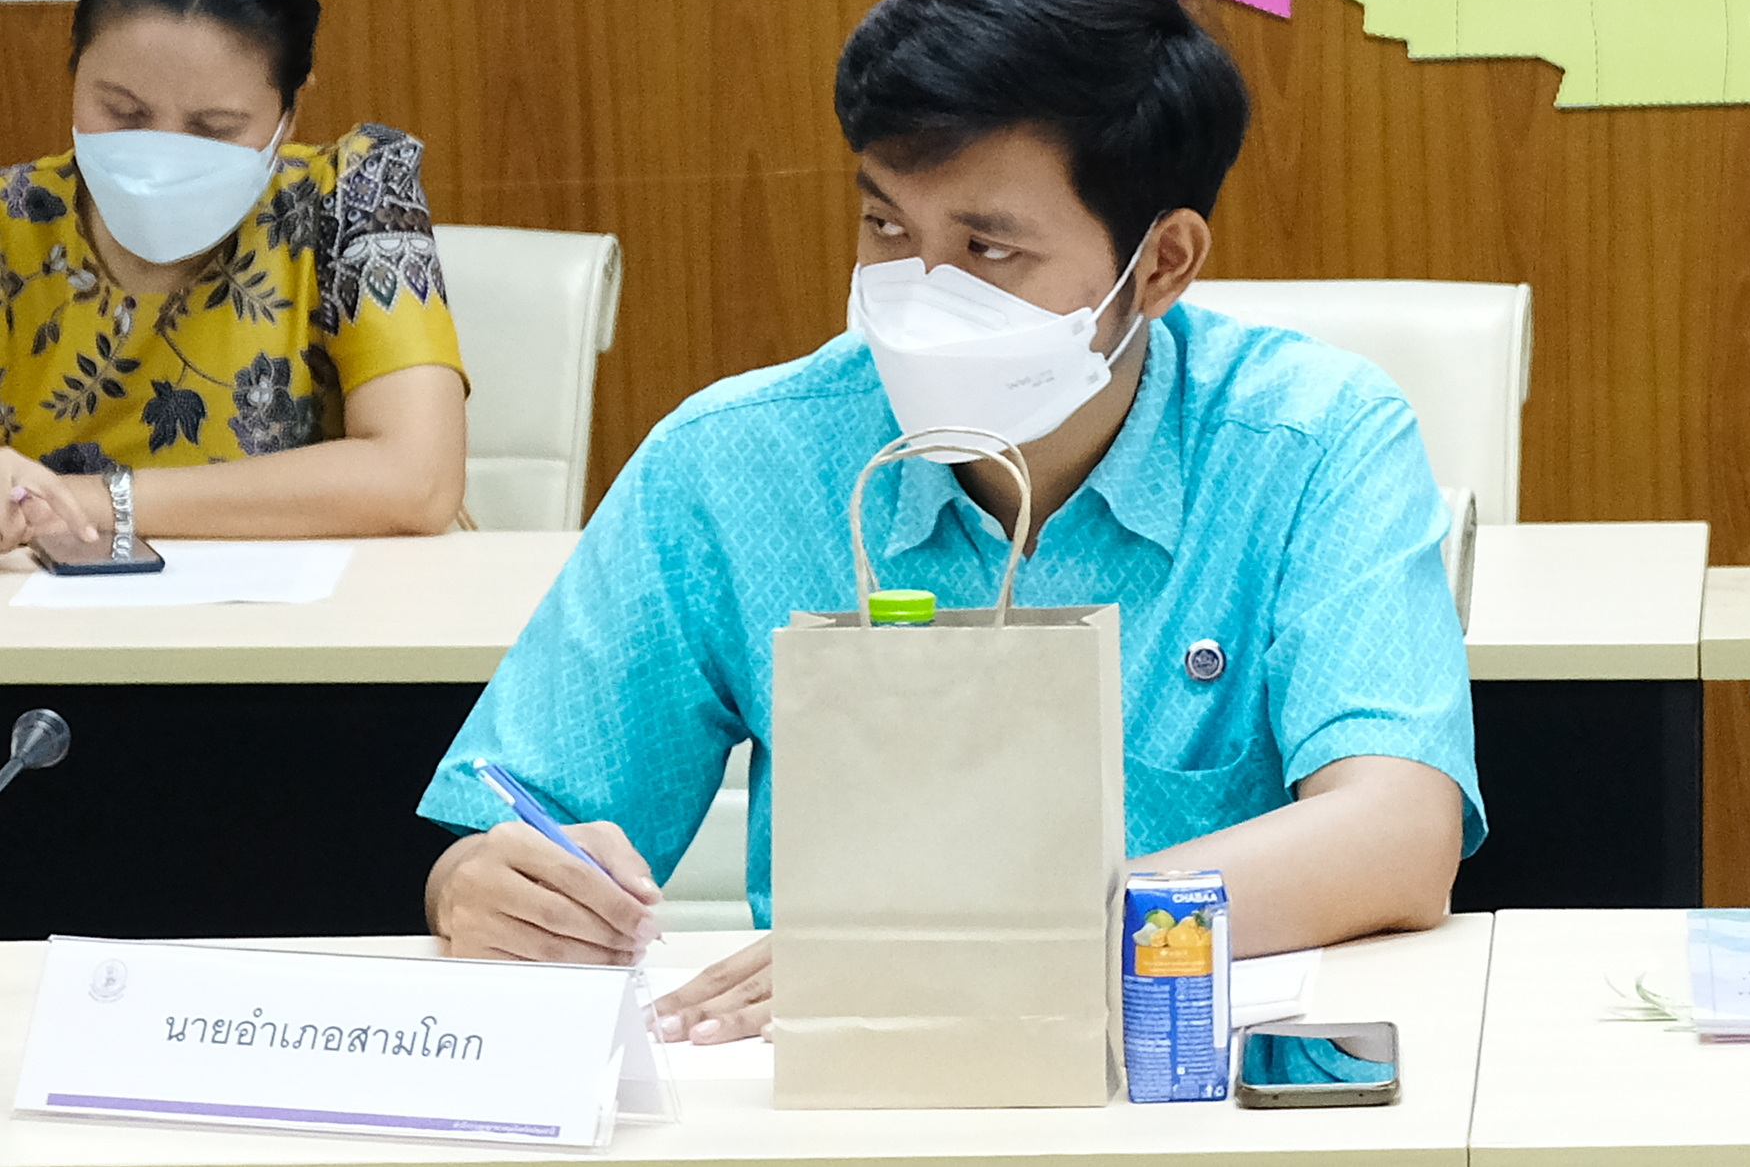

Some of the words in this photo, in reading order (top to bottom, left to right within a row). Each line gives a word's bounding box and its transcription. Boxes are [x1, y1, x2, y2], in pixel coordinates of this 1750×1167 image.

[166, 1008, 484, 1061] นายอำเภอสามโคก
